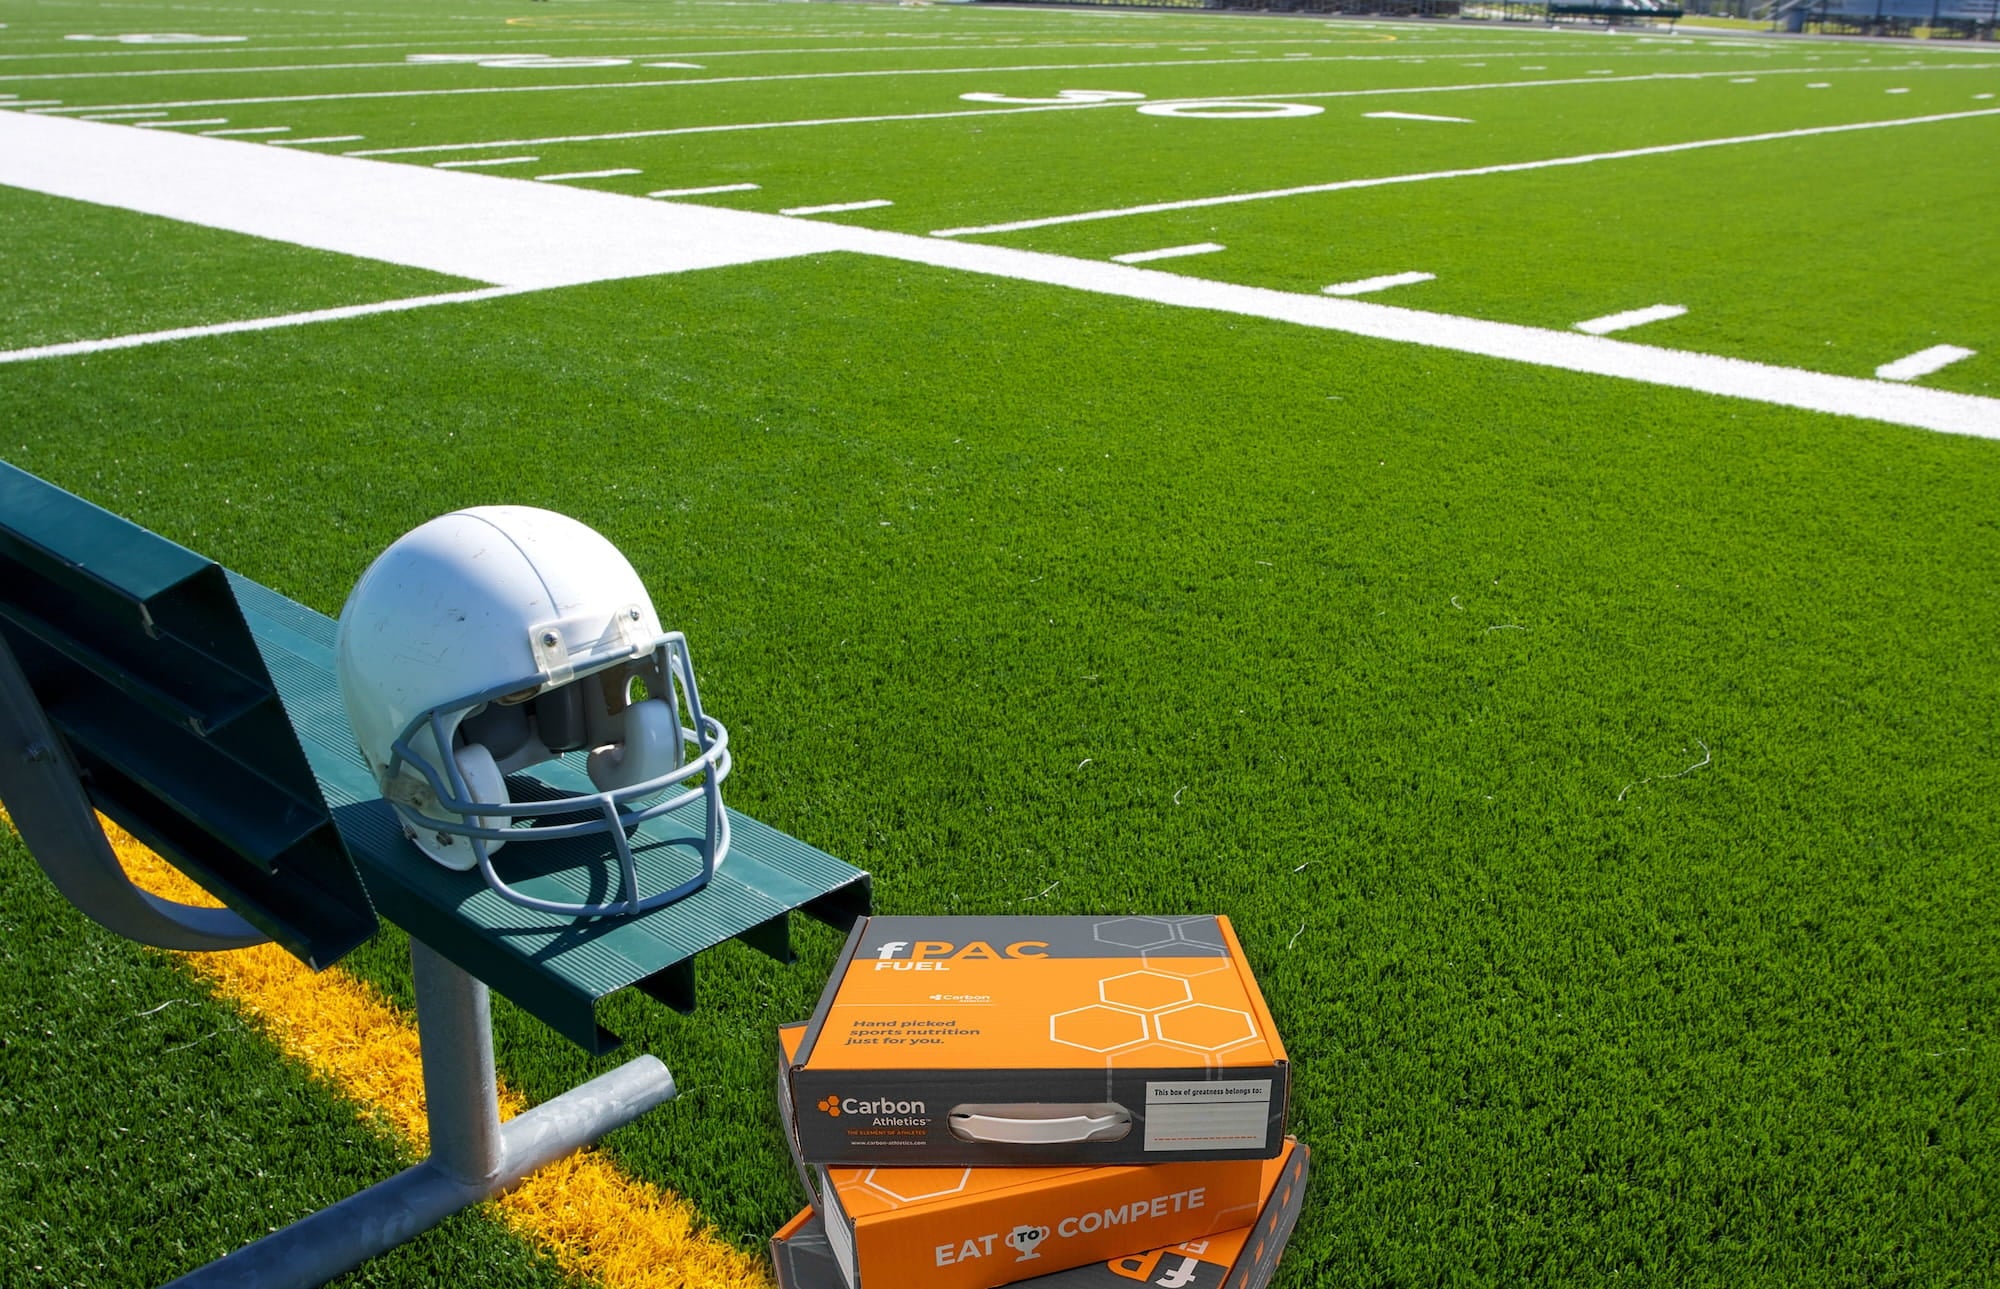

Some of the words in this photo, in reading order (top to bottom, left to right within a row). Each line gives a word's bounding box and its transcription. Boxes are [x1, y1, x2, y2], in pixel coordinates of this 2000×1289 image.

[877, 941, 1049, 959] fPAC
[874, 961, 950, 971] FUEL
[901, 1020, 956, 1028] picked
[849, 1028, 902, 1036] sports
[846, 1037, 879, 1045] just
[883, 1036, 907, 1044] for
[909, 1038, 945, 1046] you.
[1225, 1088, 1251, 1096] belongs
[842, 1097, 925, 1114] Carbon
[935, 1233, 998, 1267] EAT
[1017, 1229, 1040, 1243] TO
[1057, 1187, 1206, 1238] COMPETE
